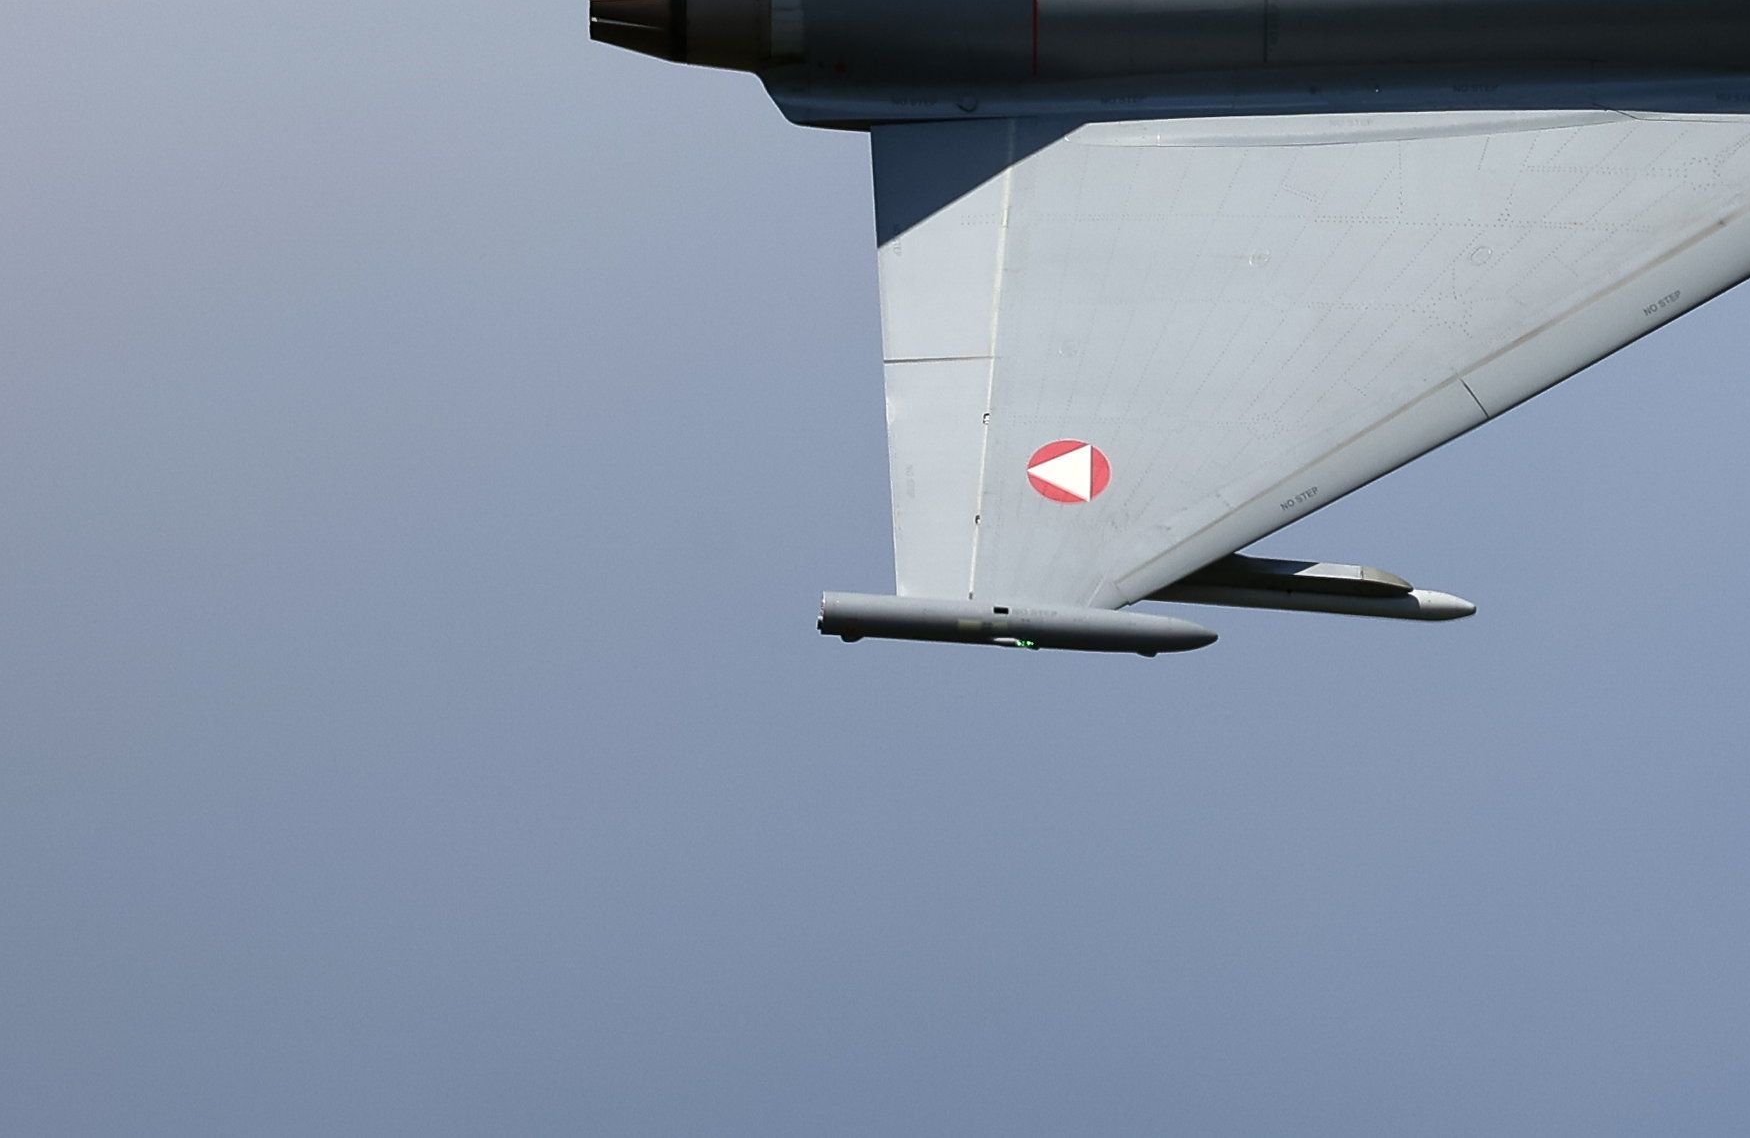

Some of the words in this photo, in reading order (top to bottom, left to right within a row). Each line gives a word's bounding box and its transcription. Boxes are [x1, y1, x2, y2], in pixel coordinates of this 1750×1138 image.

[1643, 303, 1658, 316] NO
[1657, 289, 1681, 307] STEP
[1280, 498, 1295, 511] NO
[1294, 486, 1318, 503] STEP
